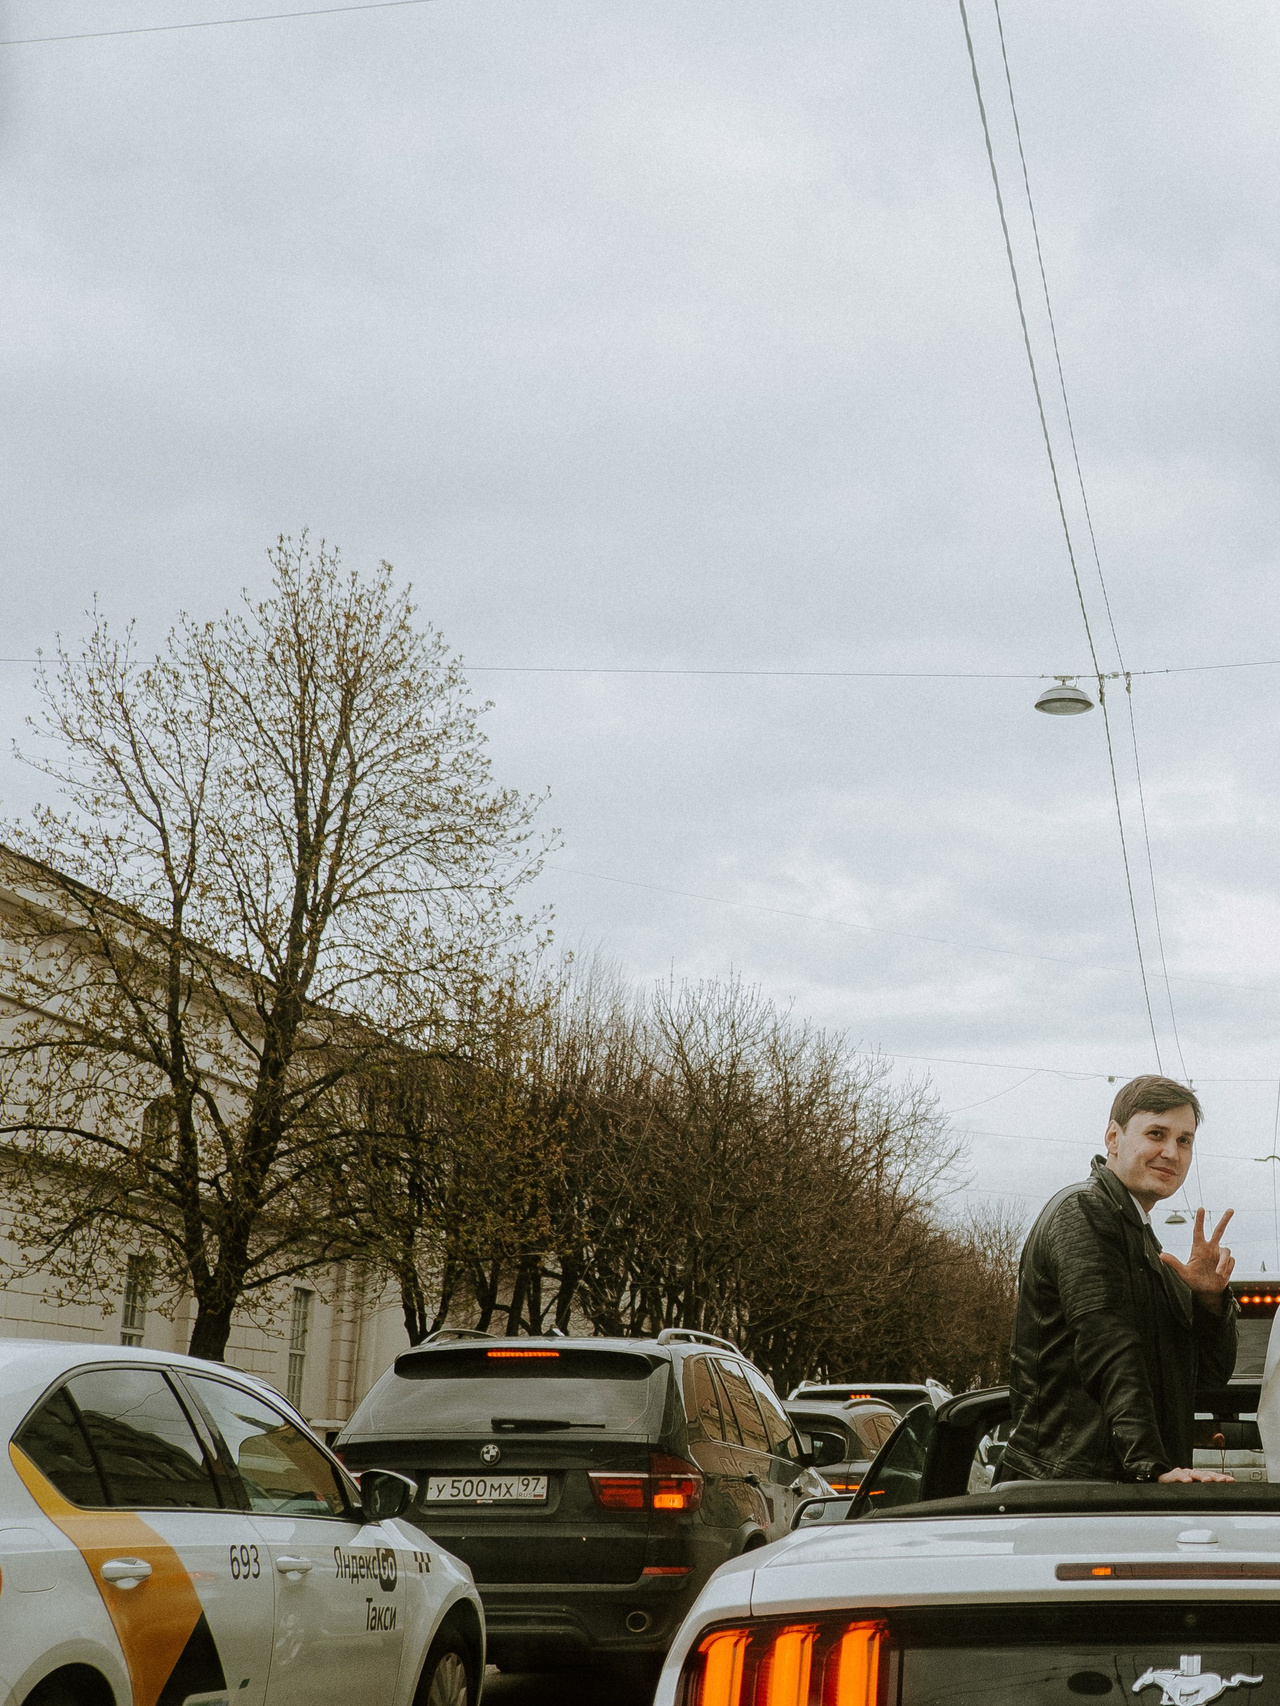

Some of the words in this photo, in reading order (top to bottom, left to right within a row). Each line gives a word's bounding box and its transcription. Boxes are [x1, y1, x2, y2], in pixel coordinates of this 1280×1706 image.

[521, 1477, 541, 1492] 97
[230, 1544, 261, 1580] 693
[333, 1545, 379, 1584] Яндекс
[381, 1548, 395, 1581] Go
[365, 1597, 397, 1632] Такси
